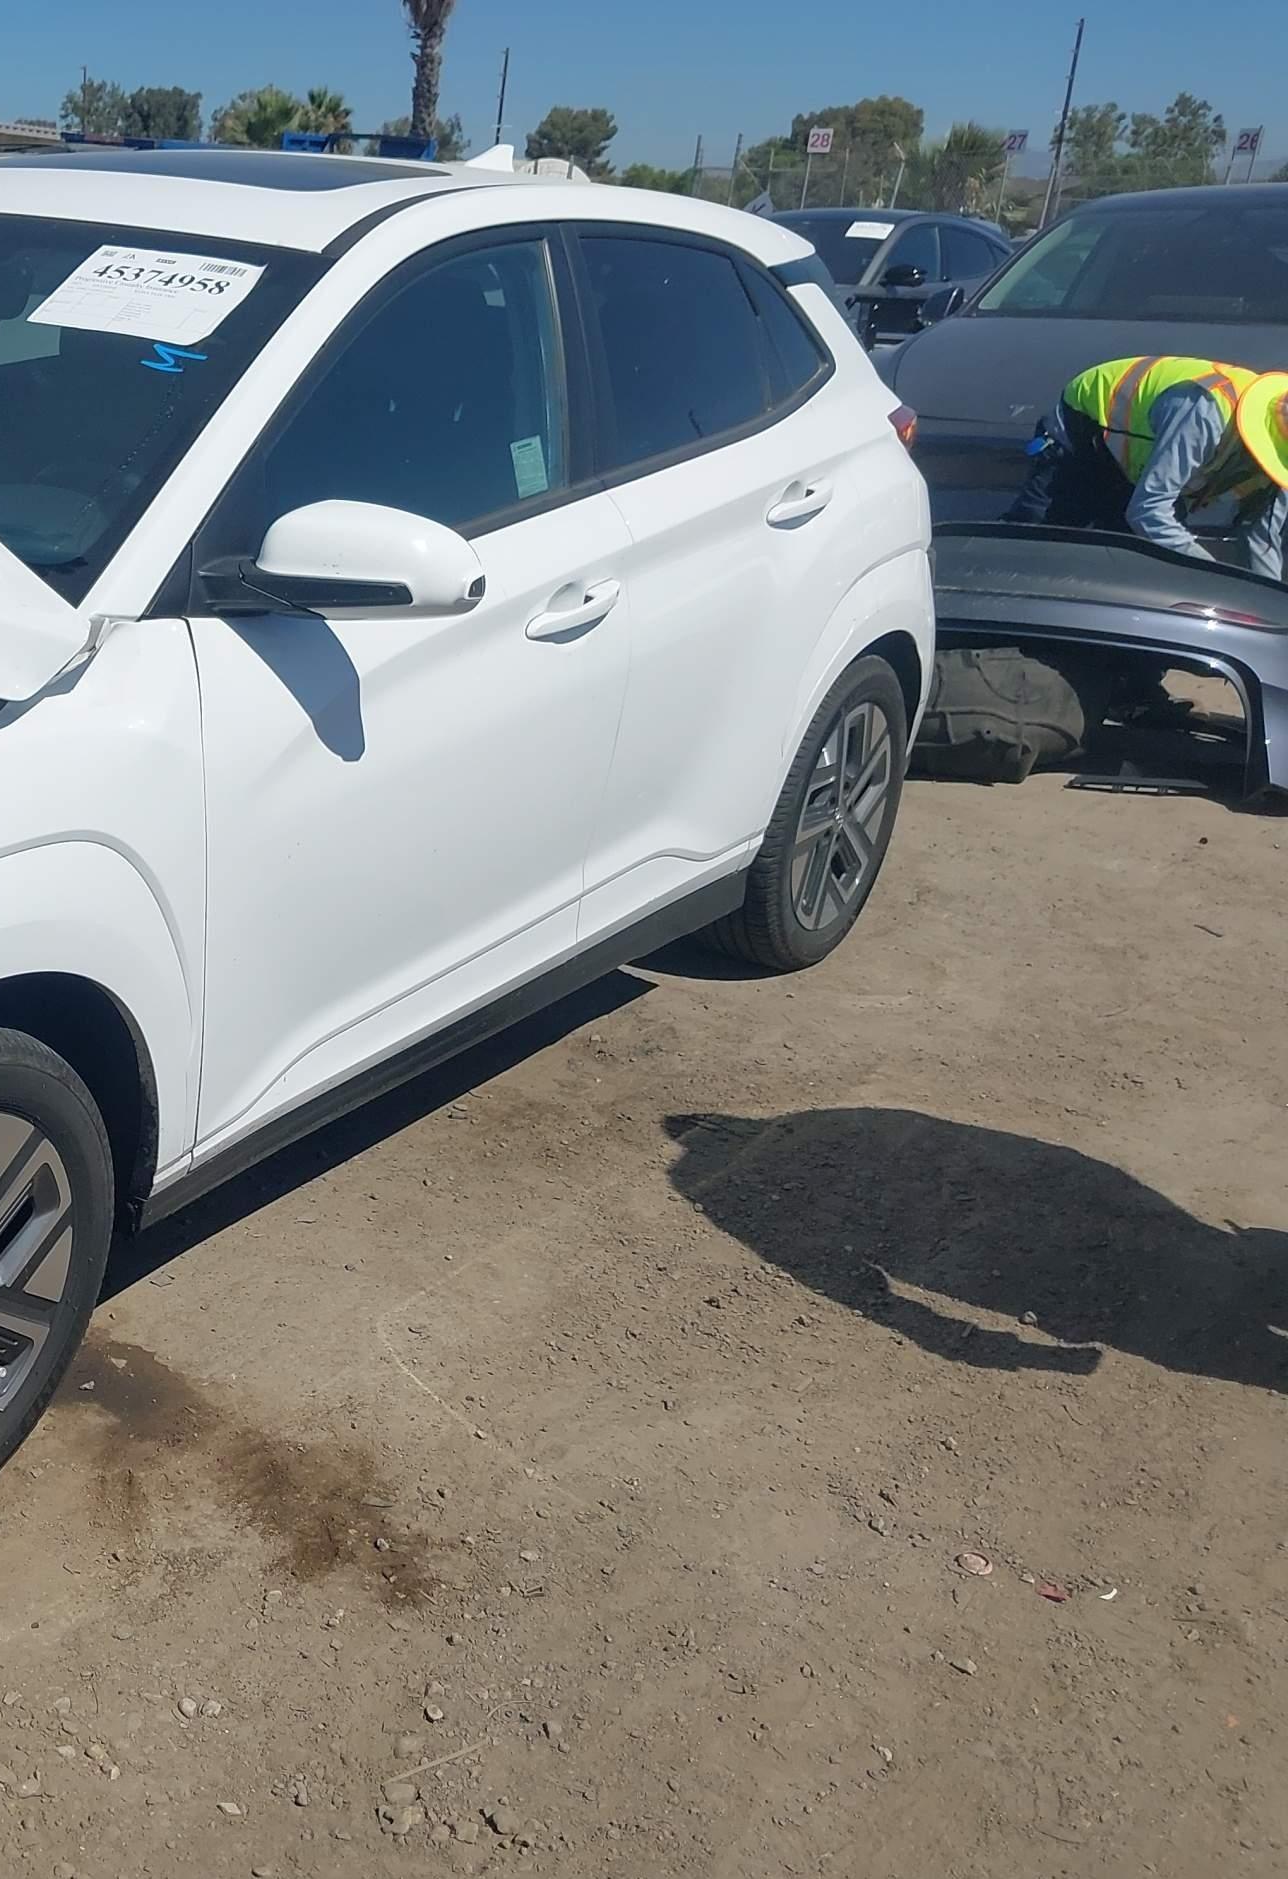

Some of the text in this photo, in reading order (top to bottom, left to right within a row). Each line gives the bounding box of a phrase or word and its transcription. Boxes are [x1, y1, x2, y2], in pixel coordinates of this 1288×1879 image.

[810, 132, 831, 148] 28
[1007, 134, 1027, 150] 27
[92, 264, 231, 296] 45374958
